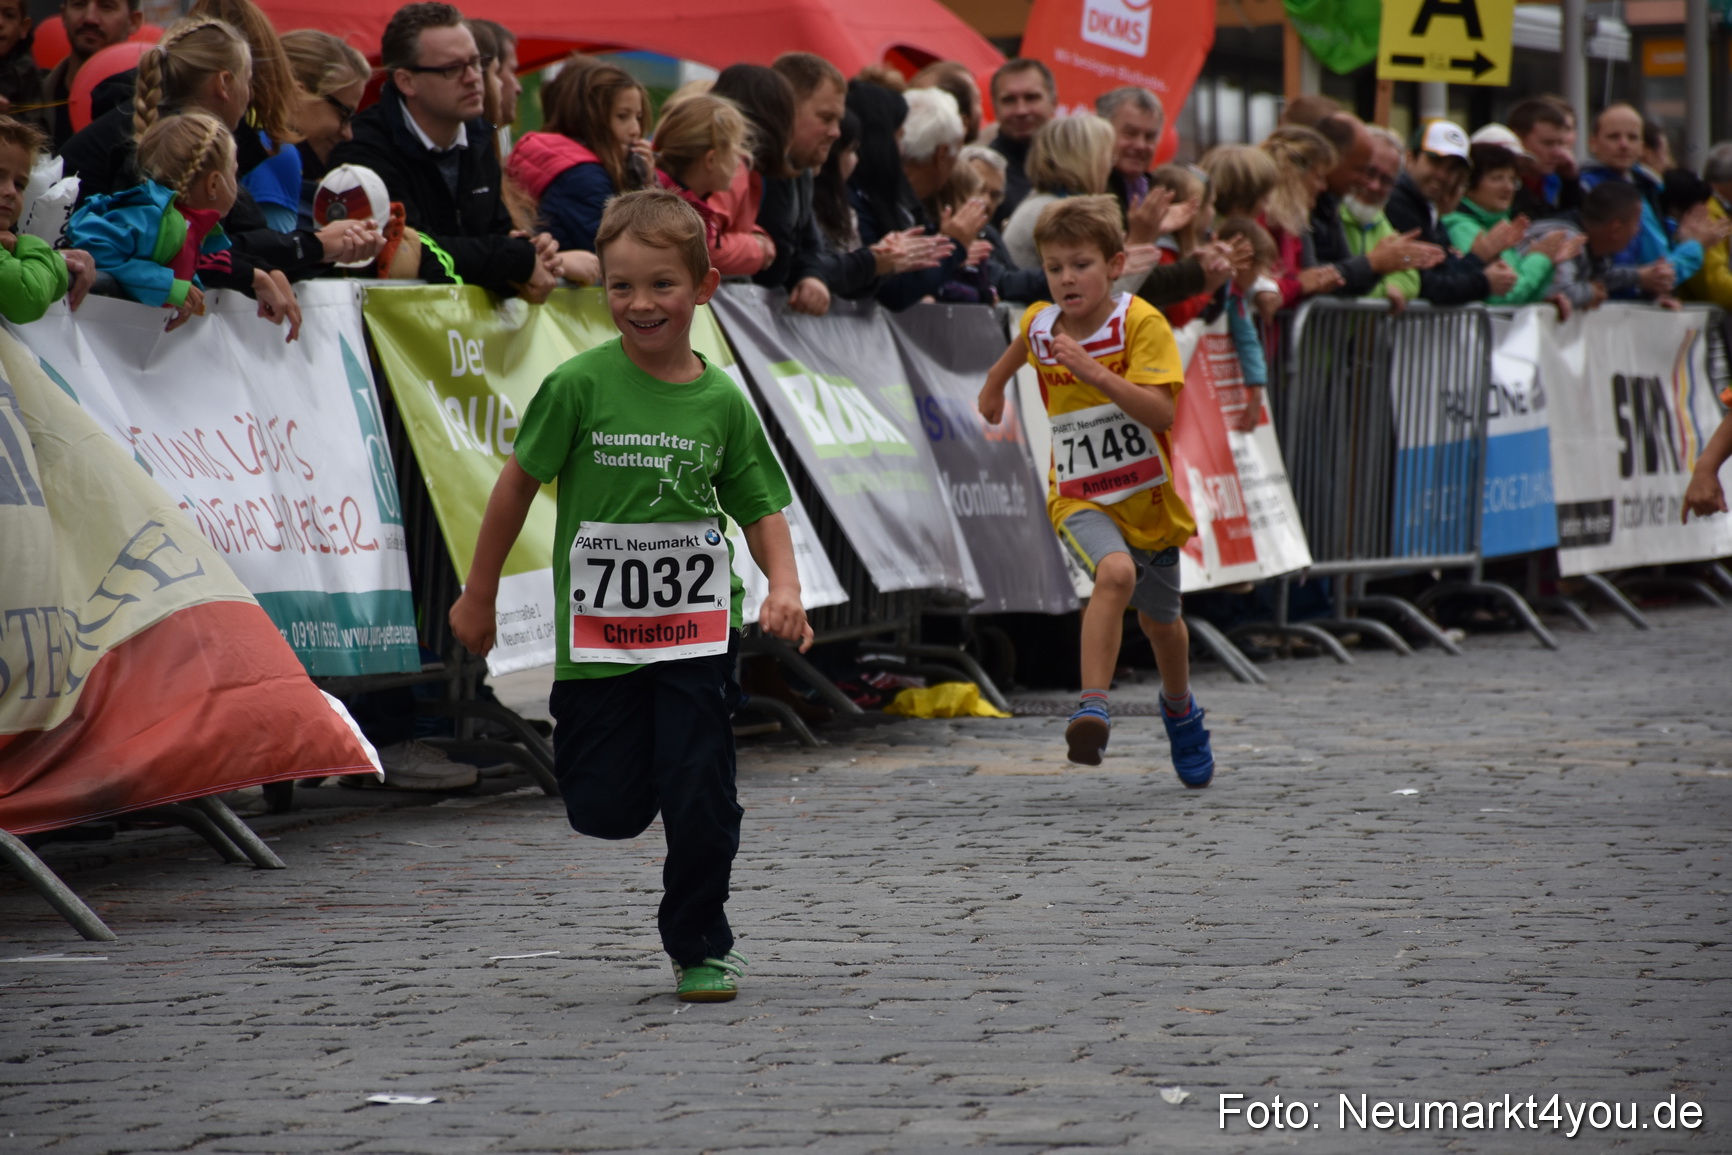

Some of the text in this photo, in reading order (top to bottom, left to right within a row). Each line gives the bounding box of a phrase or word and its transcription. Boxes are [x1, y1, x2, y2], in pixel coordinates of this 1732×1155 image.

[1087, 9, 1143, 46] DKMS
[1409, 0, 1484, 40] A
[1052, 411, 1126, 435] PARTL Neumarkt
[592, 431, 696, 451] Neumarkter
[1062, 423, 1147, 475] 7148
[593, 450, 674, 472] Stadtlauf
[1082, 471, 1139, 496] Andreas
[575, 536, 623, 551] PARTL
[627, 535, 701, 551] Neumarkt
[587, 553, 715, 609] 7032
[603, 619, 698, 644] Christoph
